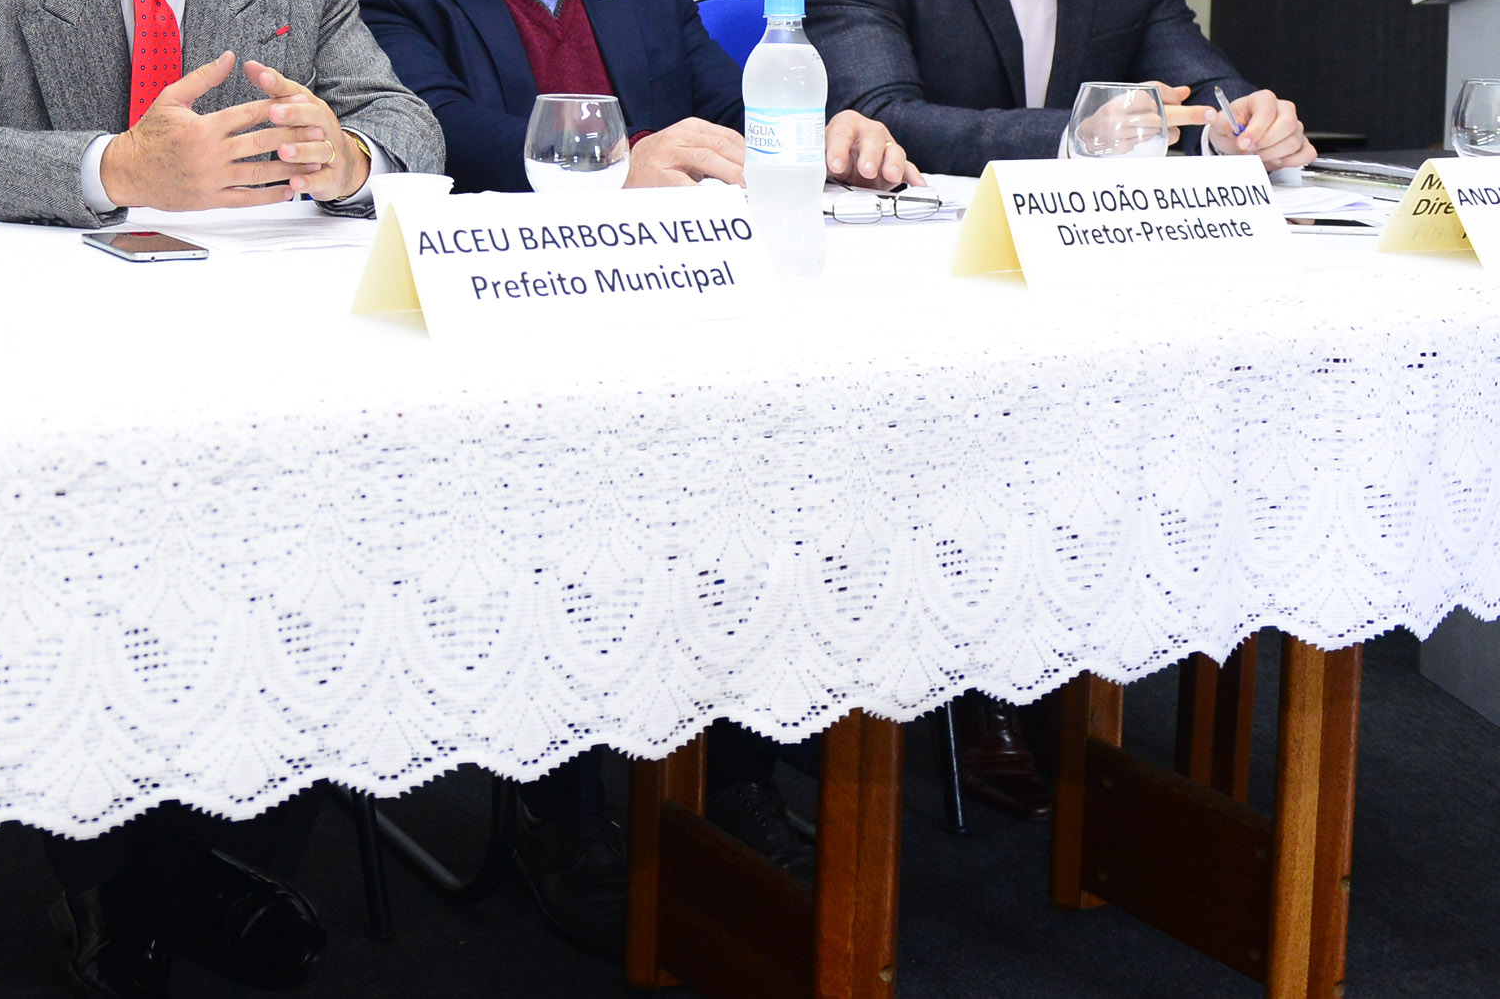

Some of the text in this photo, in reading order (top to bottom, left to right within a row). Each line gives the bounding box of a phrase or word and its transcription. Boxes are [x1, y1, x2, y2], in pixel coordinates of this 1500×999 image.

[1012, 184, 1271, 216] PAULO JOÃO BALLARDIN
[1411, 197, 1455, 216] Dire
[1457, 187, 1500, 206] AND
[418, 216, 754, 256] ALCEU BARBOSA VELHO
[1056, 217, 1255, 247] Diretor-Presidente
[470, 260, 736, 300] Prefeito Municipal
